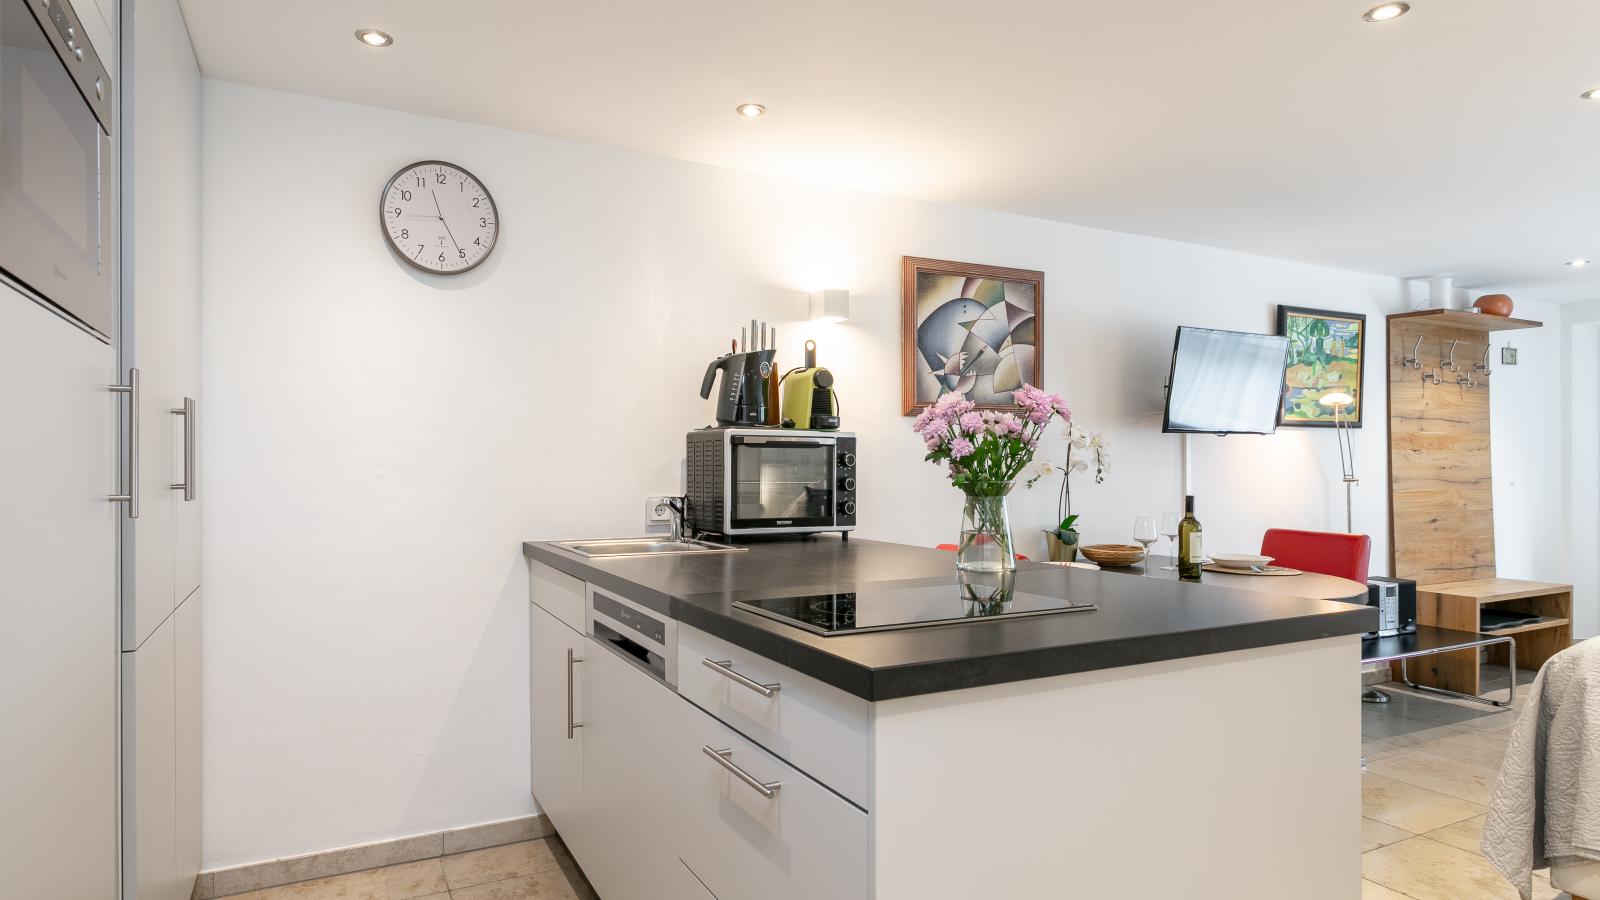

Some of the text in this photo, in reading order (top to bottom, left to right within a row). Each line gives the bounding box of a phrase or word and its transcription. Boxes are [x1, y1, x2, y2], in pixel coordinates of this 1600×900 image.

[416, 177, 425, 188] 11
[436, 174, 446, 184] 12
[401, 190, 412, 201] 10
[472, 198, 479, 208] 2
[394, 208, 402, 218] 9
[479, 217, 487, 228] 3
[401, 229, 409, 239] 8
[473, 237, 480, 246] 4
[417, 244, 425, 254] 7
[458, 249, 466, 259] 5
[438, 252, 446, 262] 6
